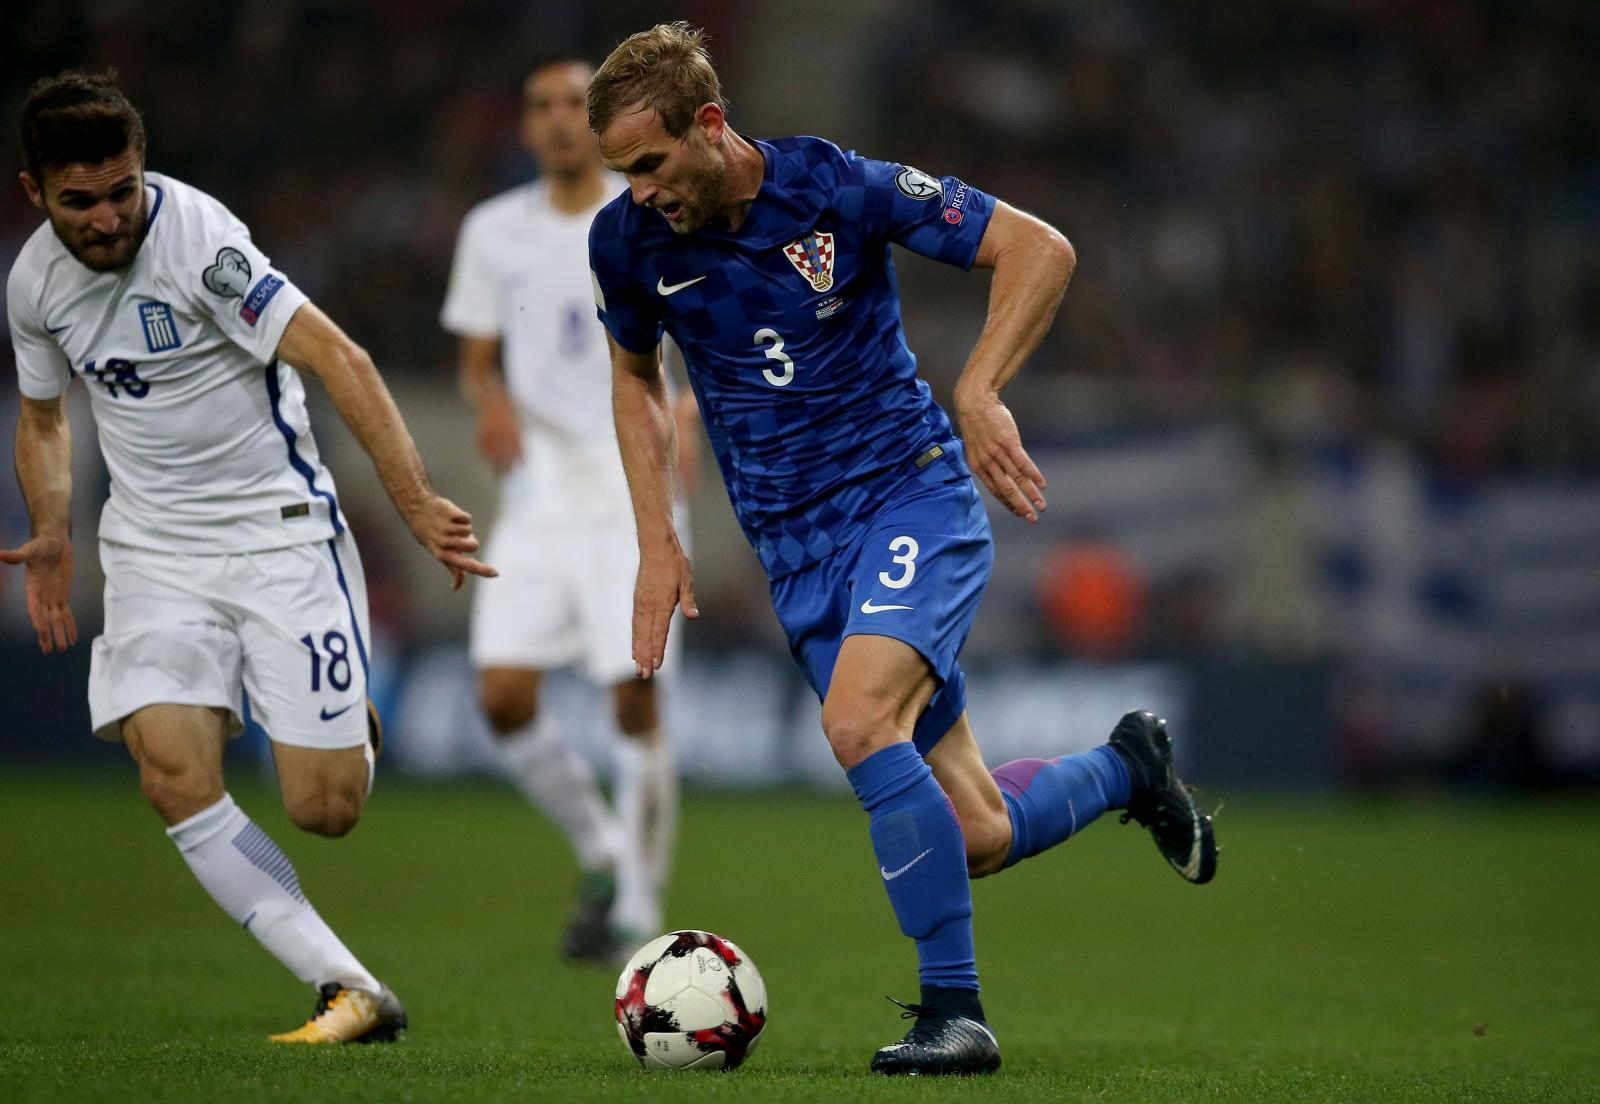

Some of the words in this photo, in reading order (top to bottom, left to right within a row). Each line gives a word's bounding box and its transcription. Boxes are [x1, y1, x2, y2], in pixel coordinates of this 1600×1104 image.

[84, 358, 150, 399] 18
[753, 328, 794, 387] 3
[879, 535, 919, 589] 3
[300, 630, 352, 692] 18
